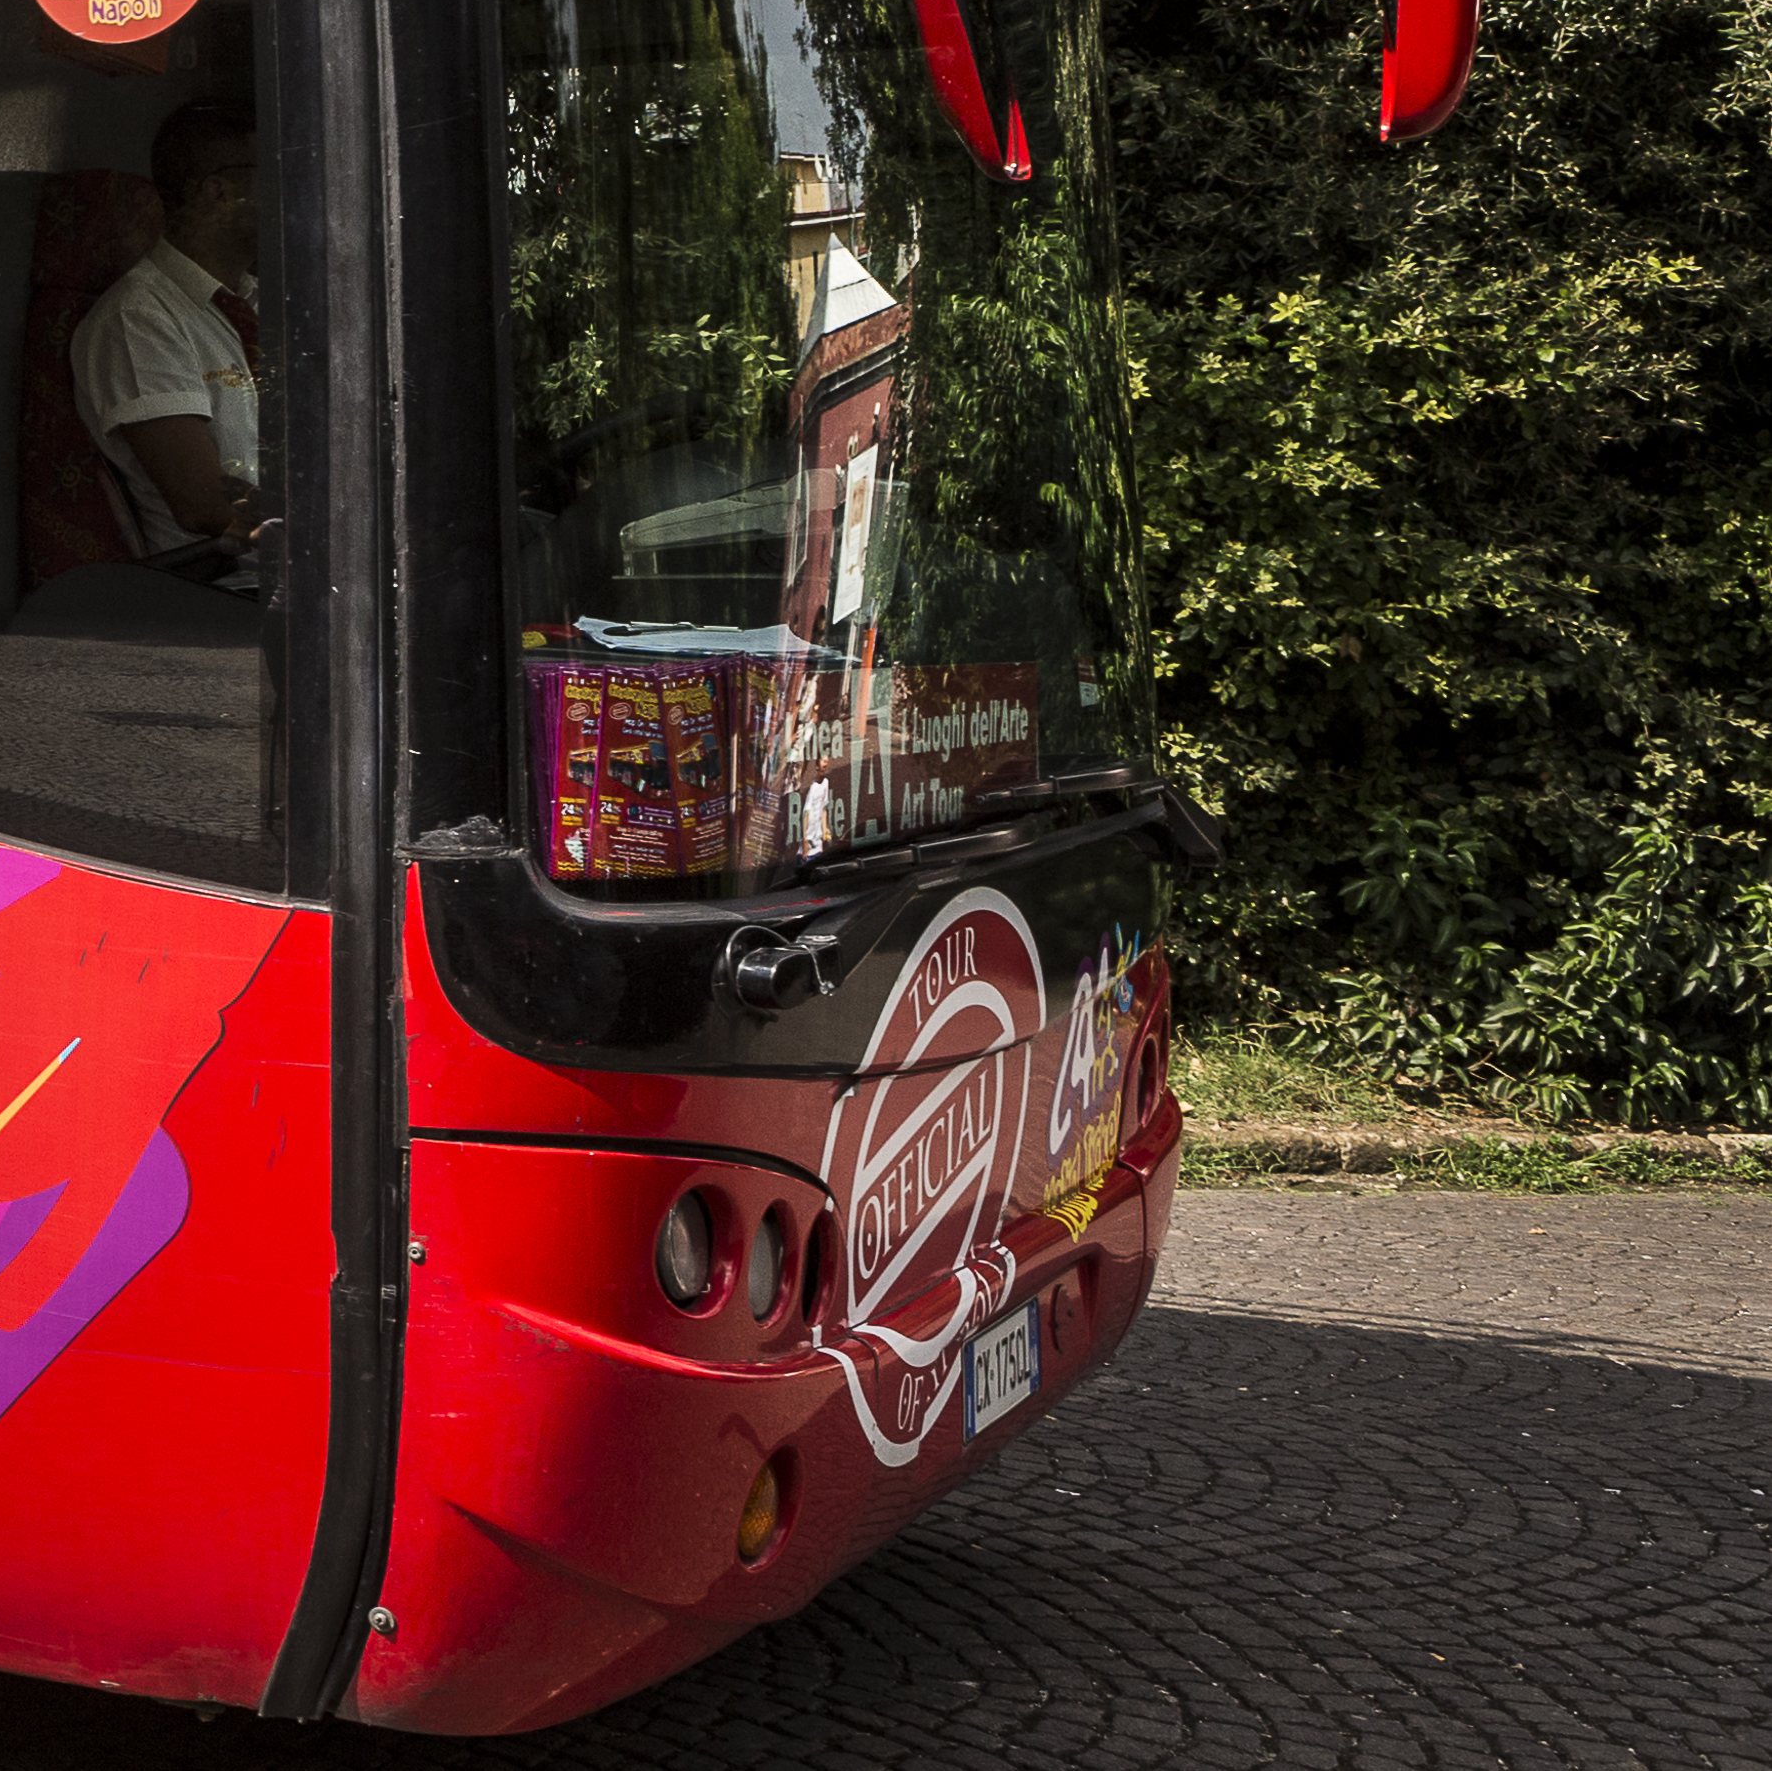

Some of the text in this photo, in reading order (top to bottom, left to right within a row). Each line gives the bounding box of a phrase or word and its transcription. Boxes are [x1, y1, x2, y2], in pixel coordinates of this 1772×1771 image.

[912, 701, 966, 763] Luoghi
[901, 777, 964, 830] Art Tour
[908, 925, 979, 1030] TOUR
[857, 1068, 993, 1281] OFFICIAL
